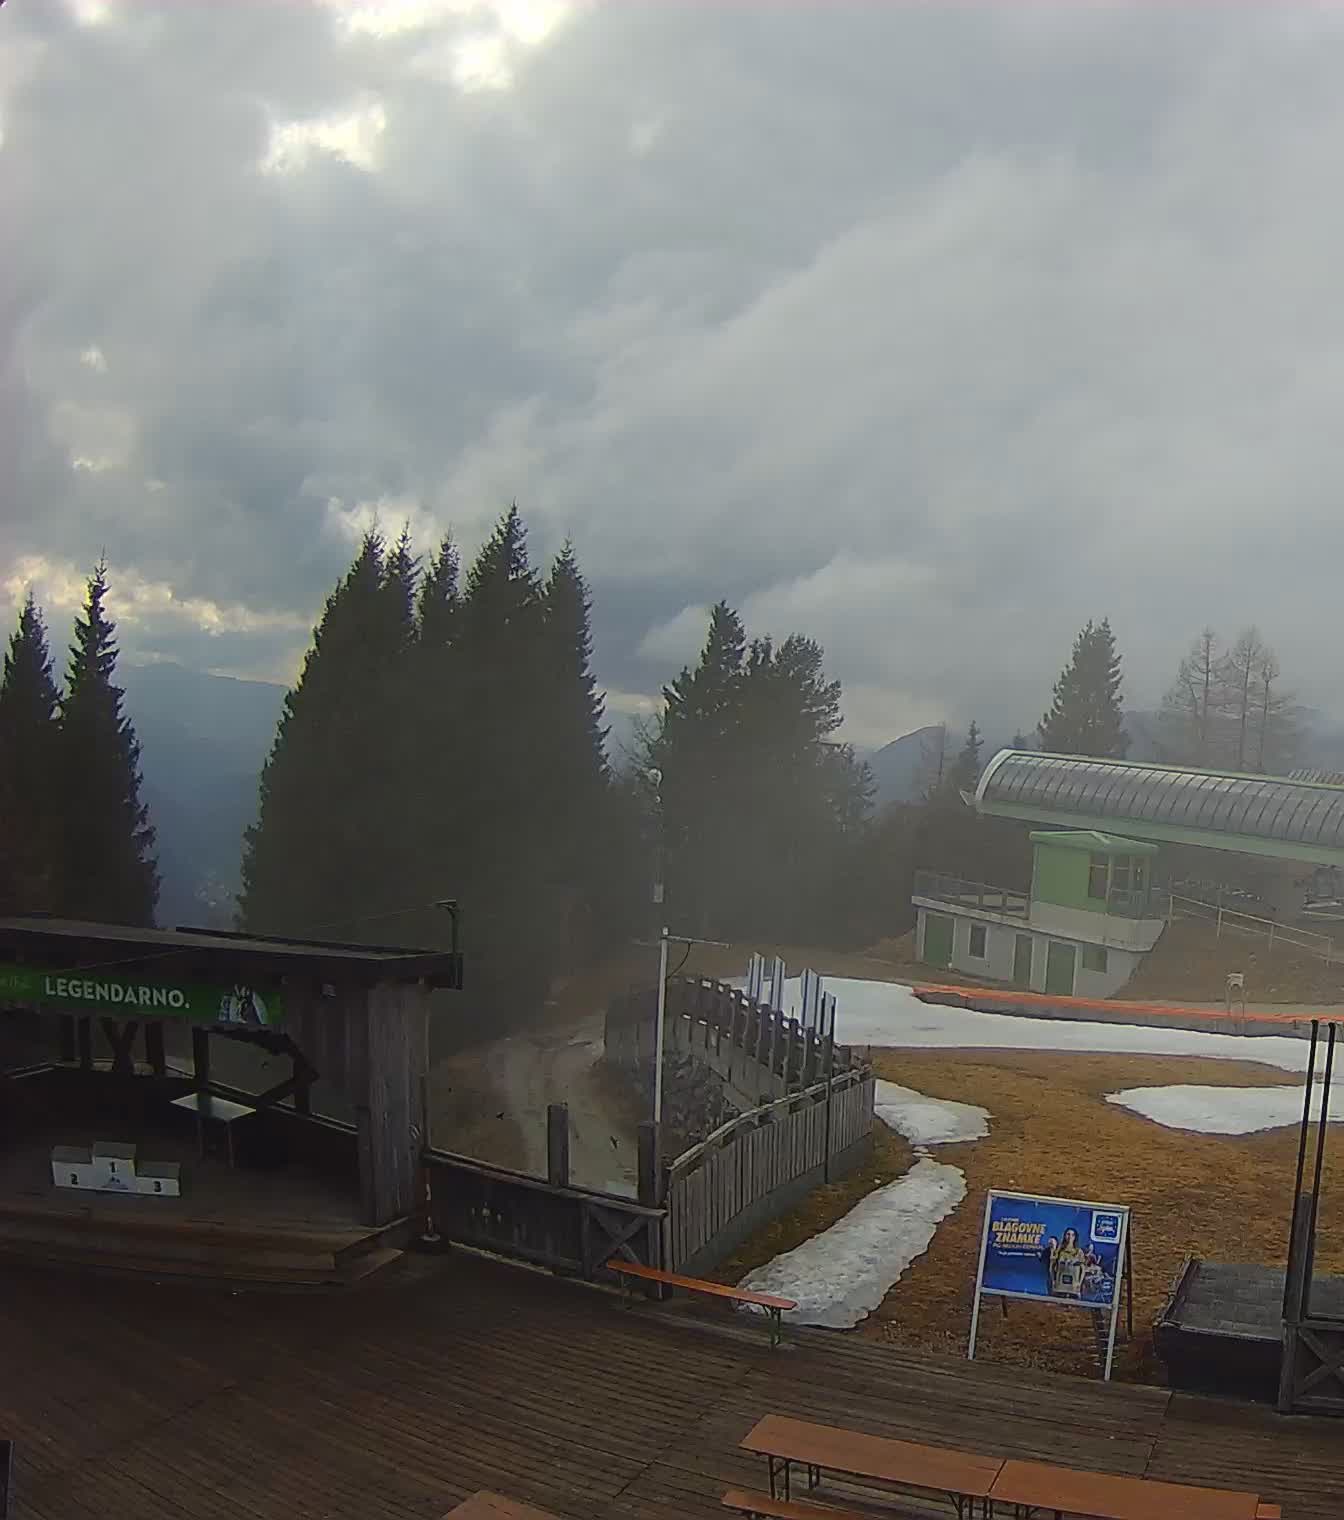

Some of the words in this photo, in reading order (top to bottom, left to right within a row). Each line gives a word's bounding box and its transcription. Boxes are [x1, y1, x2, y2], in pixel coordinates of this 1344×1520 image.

[45, 976, 191, 1009] LEGENDARNO.
[110, 1161, 116, 1173] 1
[70, 1173, 78, 1185] 2
[154, 1181, 162, 1193] 3
[992, 1221, 1046, 1234] BLAGOVNE
[996, 1233, 1041, 1244] ZNAMKE
